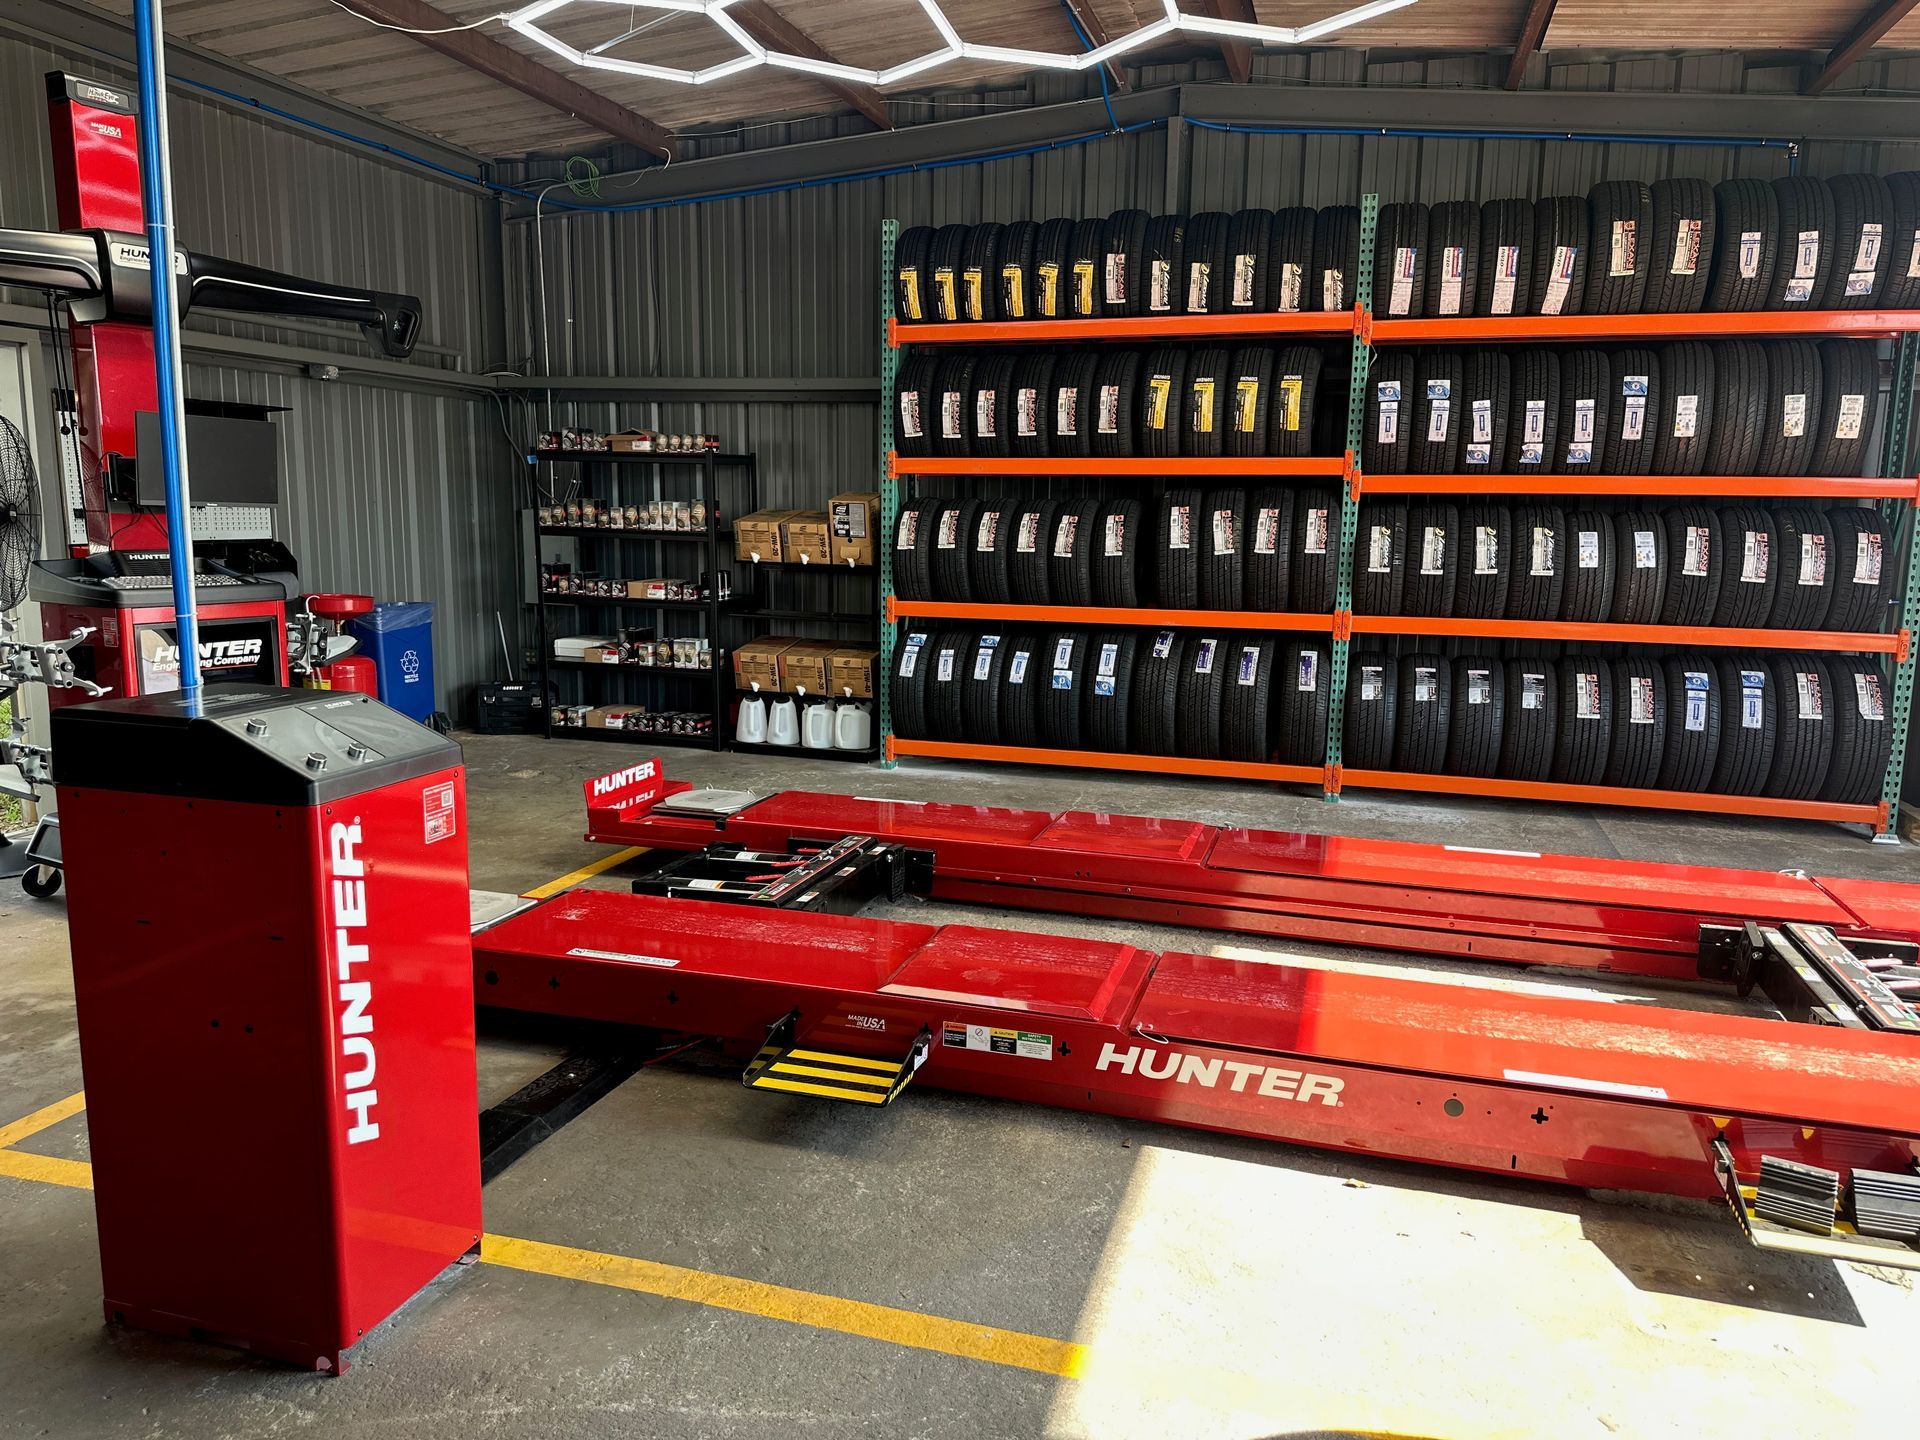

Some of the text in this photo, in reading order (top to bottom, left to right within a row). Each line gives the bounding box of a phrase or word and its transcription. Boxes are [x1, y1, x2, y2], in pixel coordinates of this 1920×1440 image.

[103, 125, 122, 137] USA
[1556, 248, 1564, 267] OTANI
[1627, 232, 1635, 269] LEXANI
[1688, 232, 1700, 269] LEXANI
[1700, 537, 1708, 571] LEXANI
[1759, 543, 1768, 576] LEXANI
[1817, 544, 1825, 580] LEXANI
[1873, 544, 1882, 578] LEXANI
[153, 638, 263, 663] HNTER
[214, 654, 260, 666] Company
[1592, 682, 1600, 713] LEXANI
[1646, 687, 1654, 718] LEXANI
[1873, 683, 1883, 714] LEXANI
[594, 761, 656, 797] HUNTER
[329, 817, 380, 1145] HUNTER
[863, 1016, 886, 1030] USA
[1095, 1042, 1345, 1108] HUNTER
